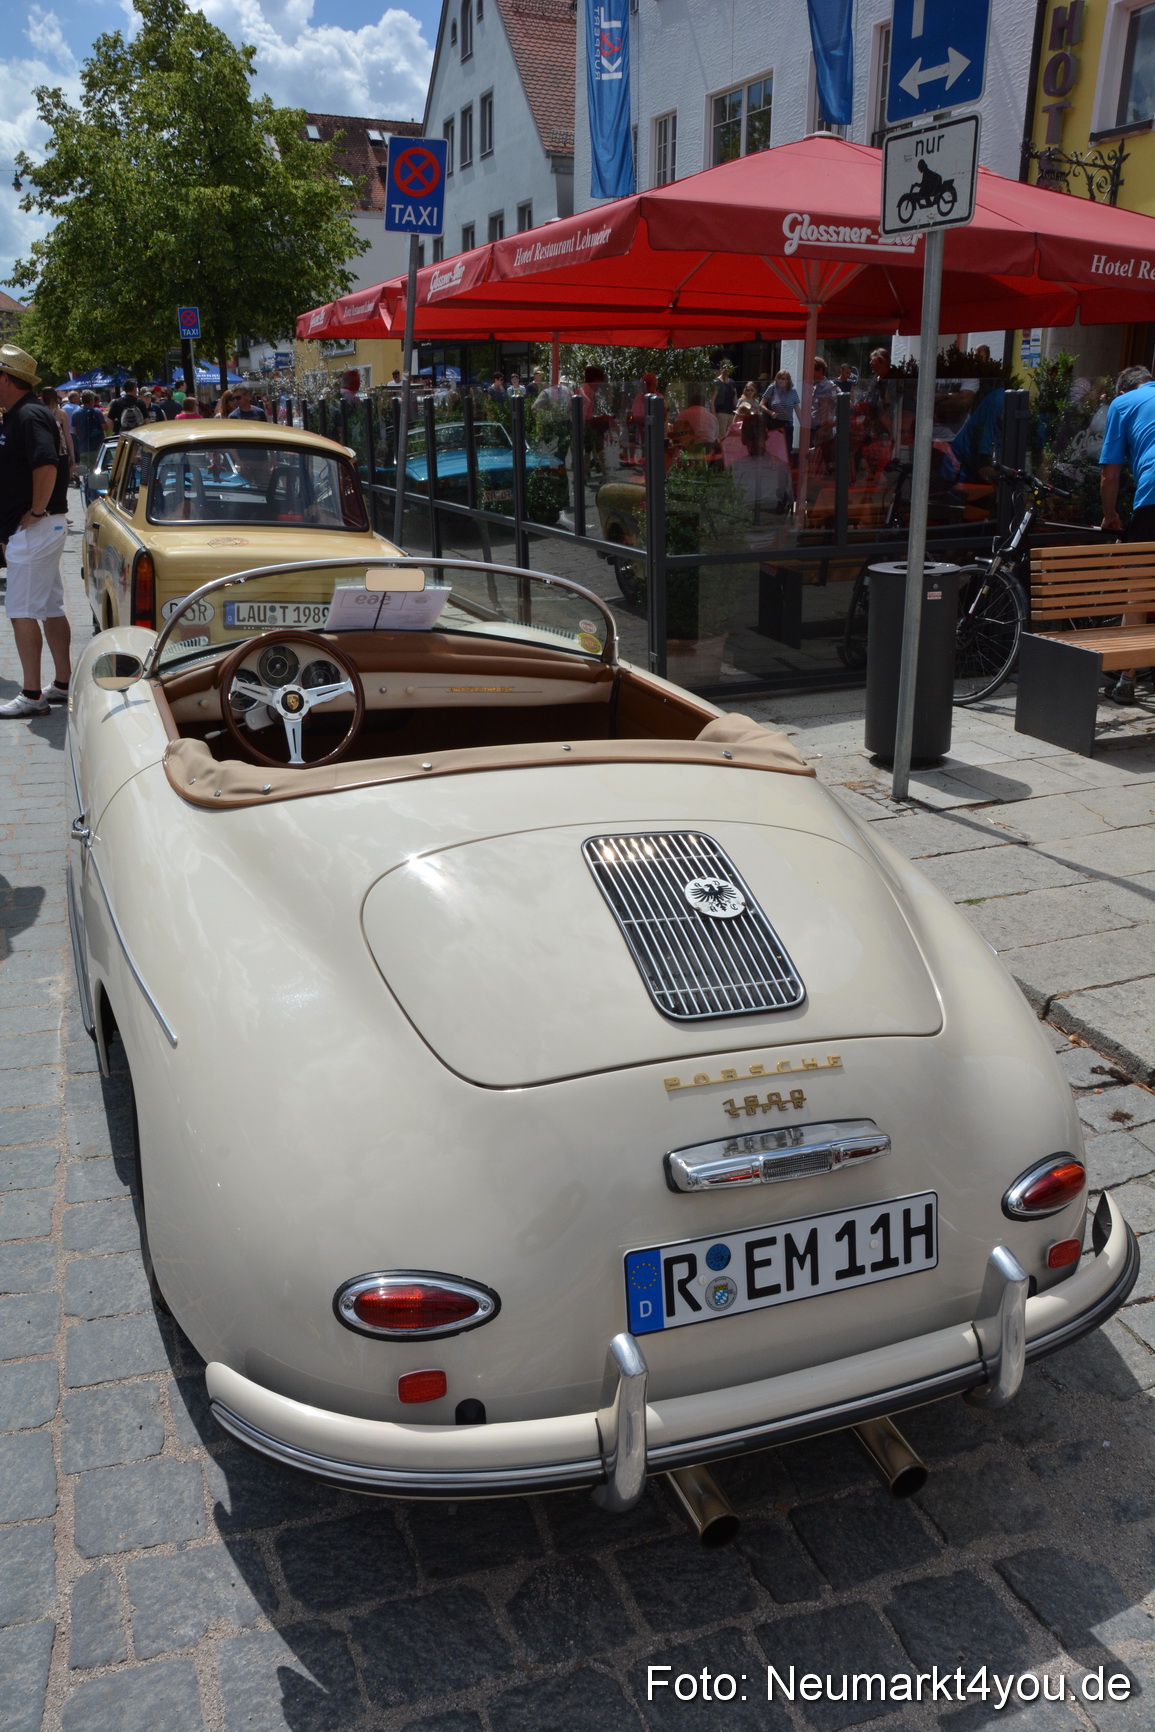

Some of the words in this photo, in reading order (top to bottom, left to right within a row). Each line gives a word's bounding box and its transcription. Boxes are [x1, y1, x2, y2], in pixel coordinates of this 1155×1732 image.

[914, 134, 945, 157] nur
[391, 204, 438, 227] TAXI
[513, 244, 534, 267] Hotel
[533, 236, 576, 261] Restaurant
[575, 224, 612, 251] Lehmeier
[1090, 254, 1135, 278] Hotel
[182, 328, 199, 336] TAXI
[236, 605, 267, 623] LAU
[280, 606, 289, 623] T
[293, 606, 329, 624] 1989
[664, 1055, 843, 1091] PORSCHE
[722, 1089, 806, 1112] 1600
[729, 1100, 804, 1118] SUPER
[640, 1300, 652, 1318] D
[663, 1253, 702, 1318] R
[745, 1227, 820, 1300] EM
[835, 1203, 934, 1280] 11H
